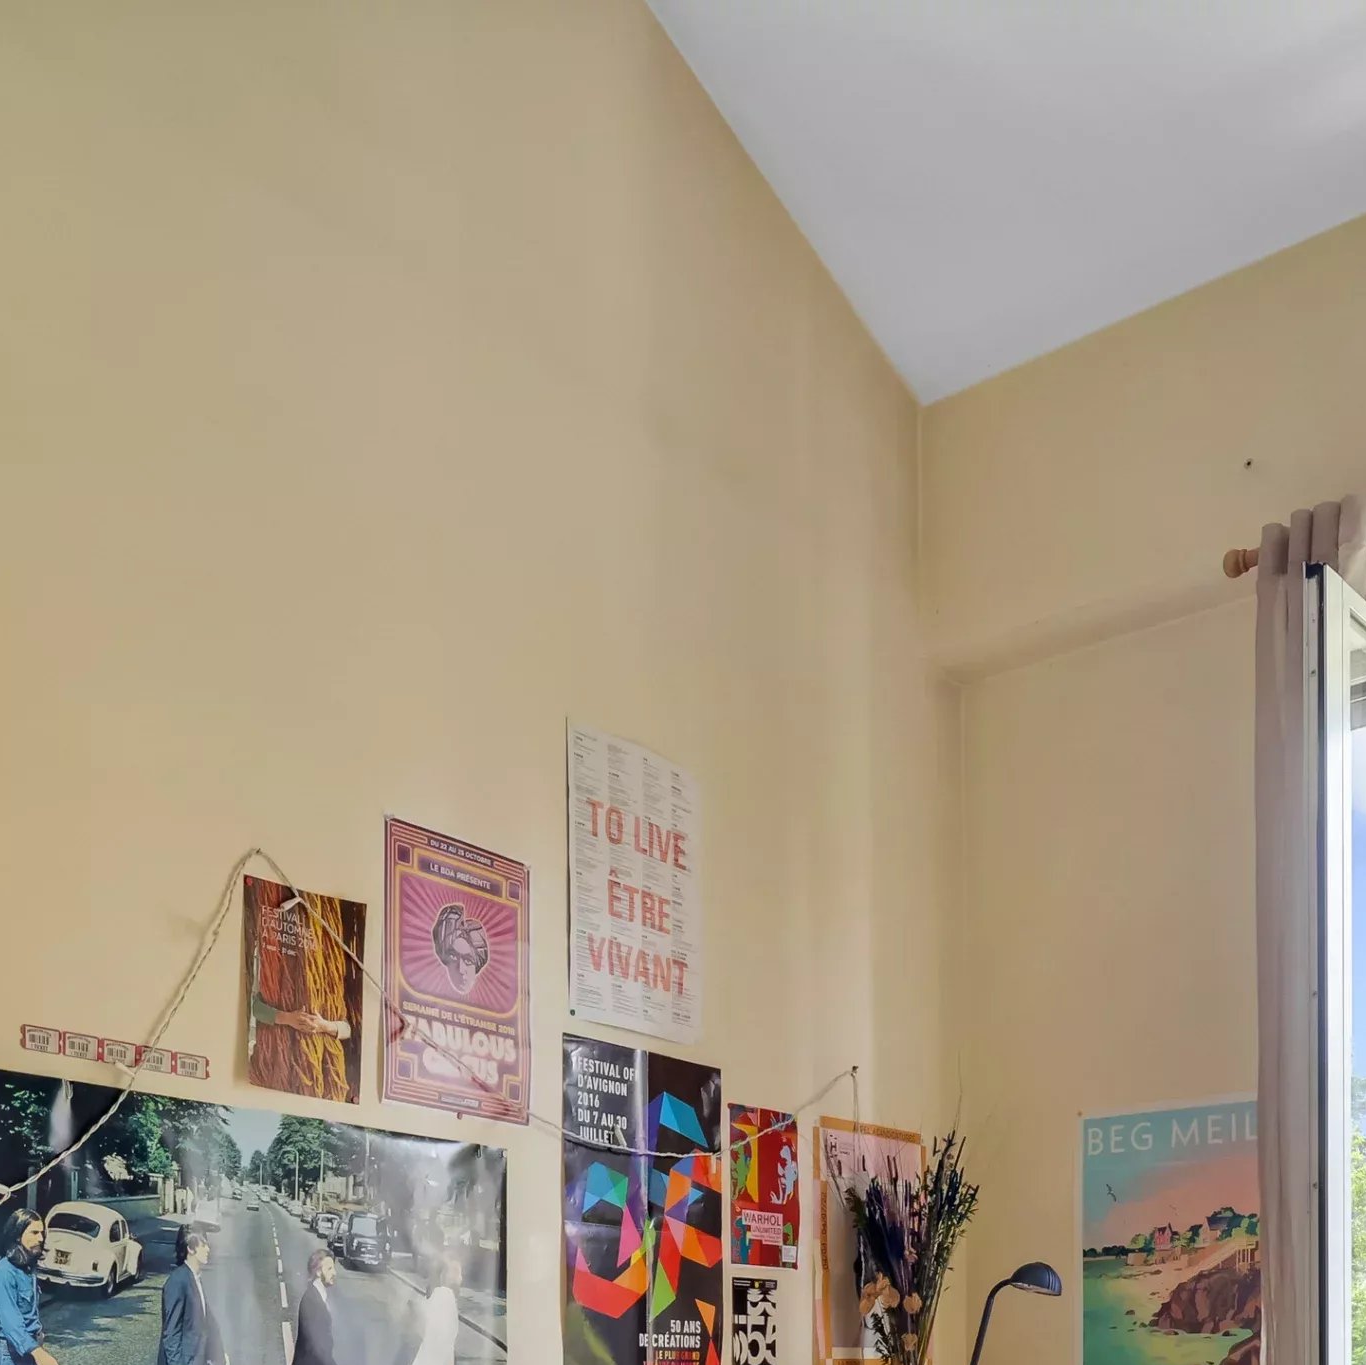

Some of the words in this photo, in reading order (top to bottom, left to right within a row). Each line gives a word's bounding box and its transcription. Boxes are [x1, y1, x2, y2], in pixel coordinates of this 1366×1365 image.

[430, 839, 439, 848] DU
[448, 845, 457, 853] AU
[586, 798, 624, 845] TO
[635, 816, 687, 872] LIVE
[429, 862, 439, 873] LE
[456, 870, 492, 890] PRÉSENTE
[607, 866, 671, 935] ÊTRE
[262, 905, 303, 925] FESTIVAL
[587, 932, 689, 996] VIVANT
[402, 1000, 439, 1019] SEMAINE
[441, 1011, 451, 1022] DE
[403, 1016, 517, 1063] FABULOUS
[578, 1056, 621, 1079] FESTIVAL
[577, 1073, 628, 1097] D'AVIGNON
[577, 1090, 600, 1108] 2016
[577, 1108, 590, 1123] DU
[593, 1111, 599, 1124] 7
[601, 1112, 614, 1128] AU
[616, 1115, 628, 1130] 30
[578, 1125, 614, 1145] JUILLET
[1086, 1120, 1154, 1157] BEG
[1170, 1110, 1258, 1149] MEIL
[743, 1211, 782, 1227] WARHOL
[670, 1319, 681, 1333] 50
[683, 1320, 702, 1334] ANS
[638, 1332, 648, 1347] DE
[651, 1331, 701, 1349] CRÉATIONS
